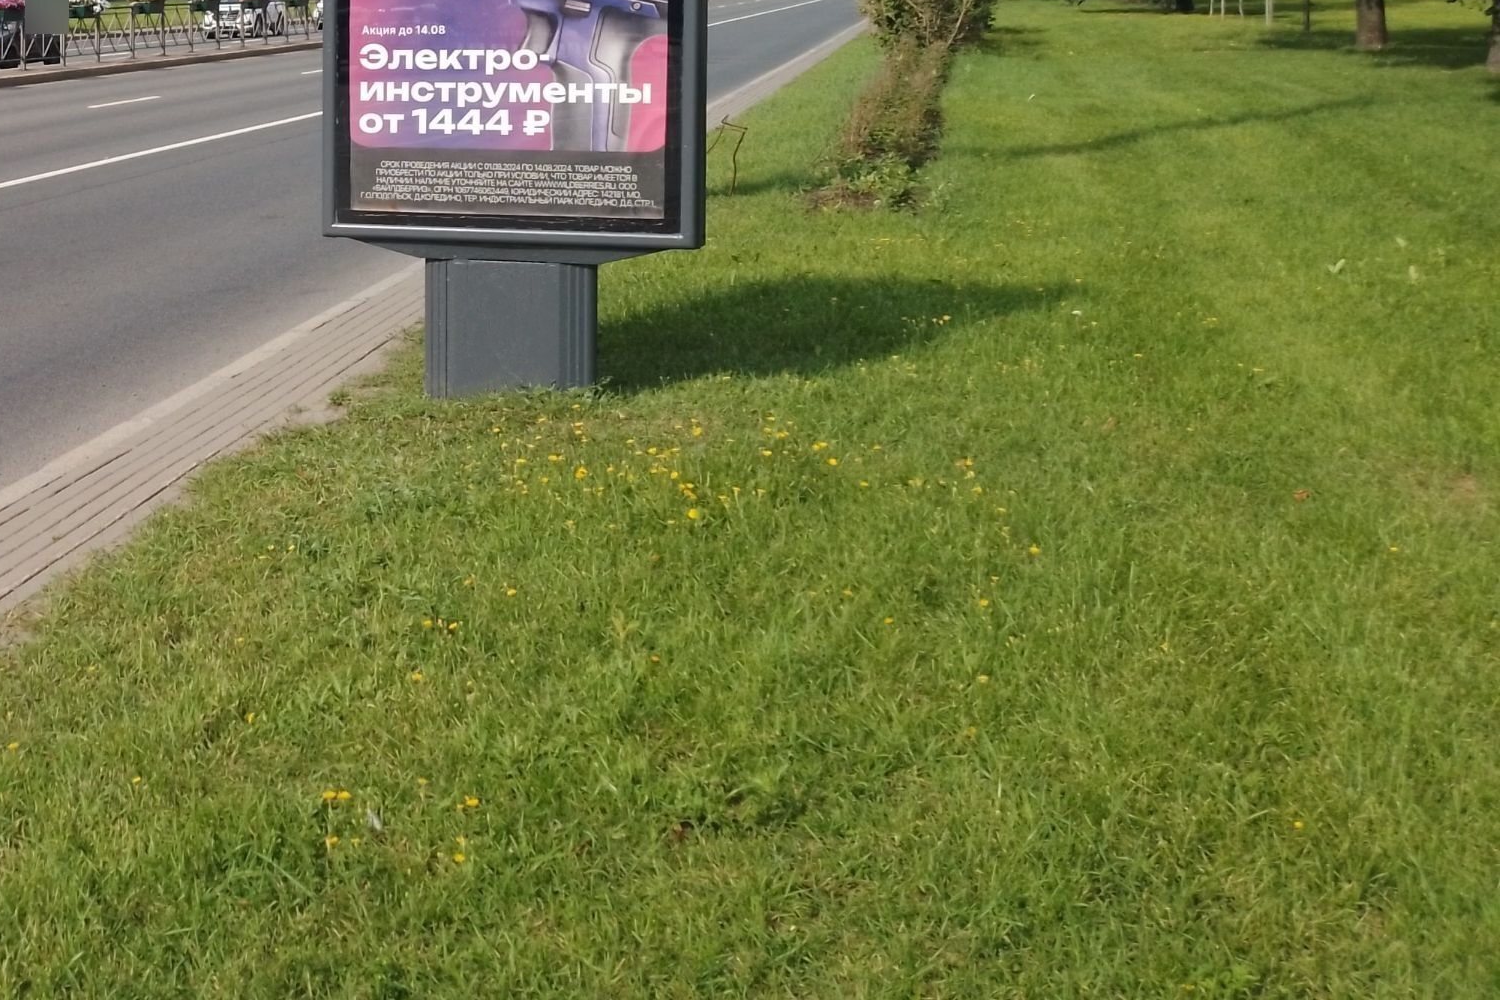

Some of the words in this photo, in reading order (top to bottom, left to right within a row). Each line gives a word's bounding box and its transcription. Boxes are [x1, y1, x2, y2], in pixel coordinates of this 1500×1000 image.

[361, 25, 396, 37] Акция
[398, 26, 413, 37] до
[414, 25, 446, 36] 14.08
[359, 43, 550, 76] Электро-
[359, 81, 652, 109] инструменты
[359, 113, 405, 135] от
[411, 108, 514, 137] 1444
[522, 109, 551, 137] ₽
